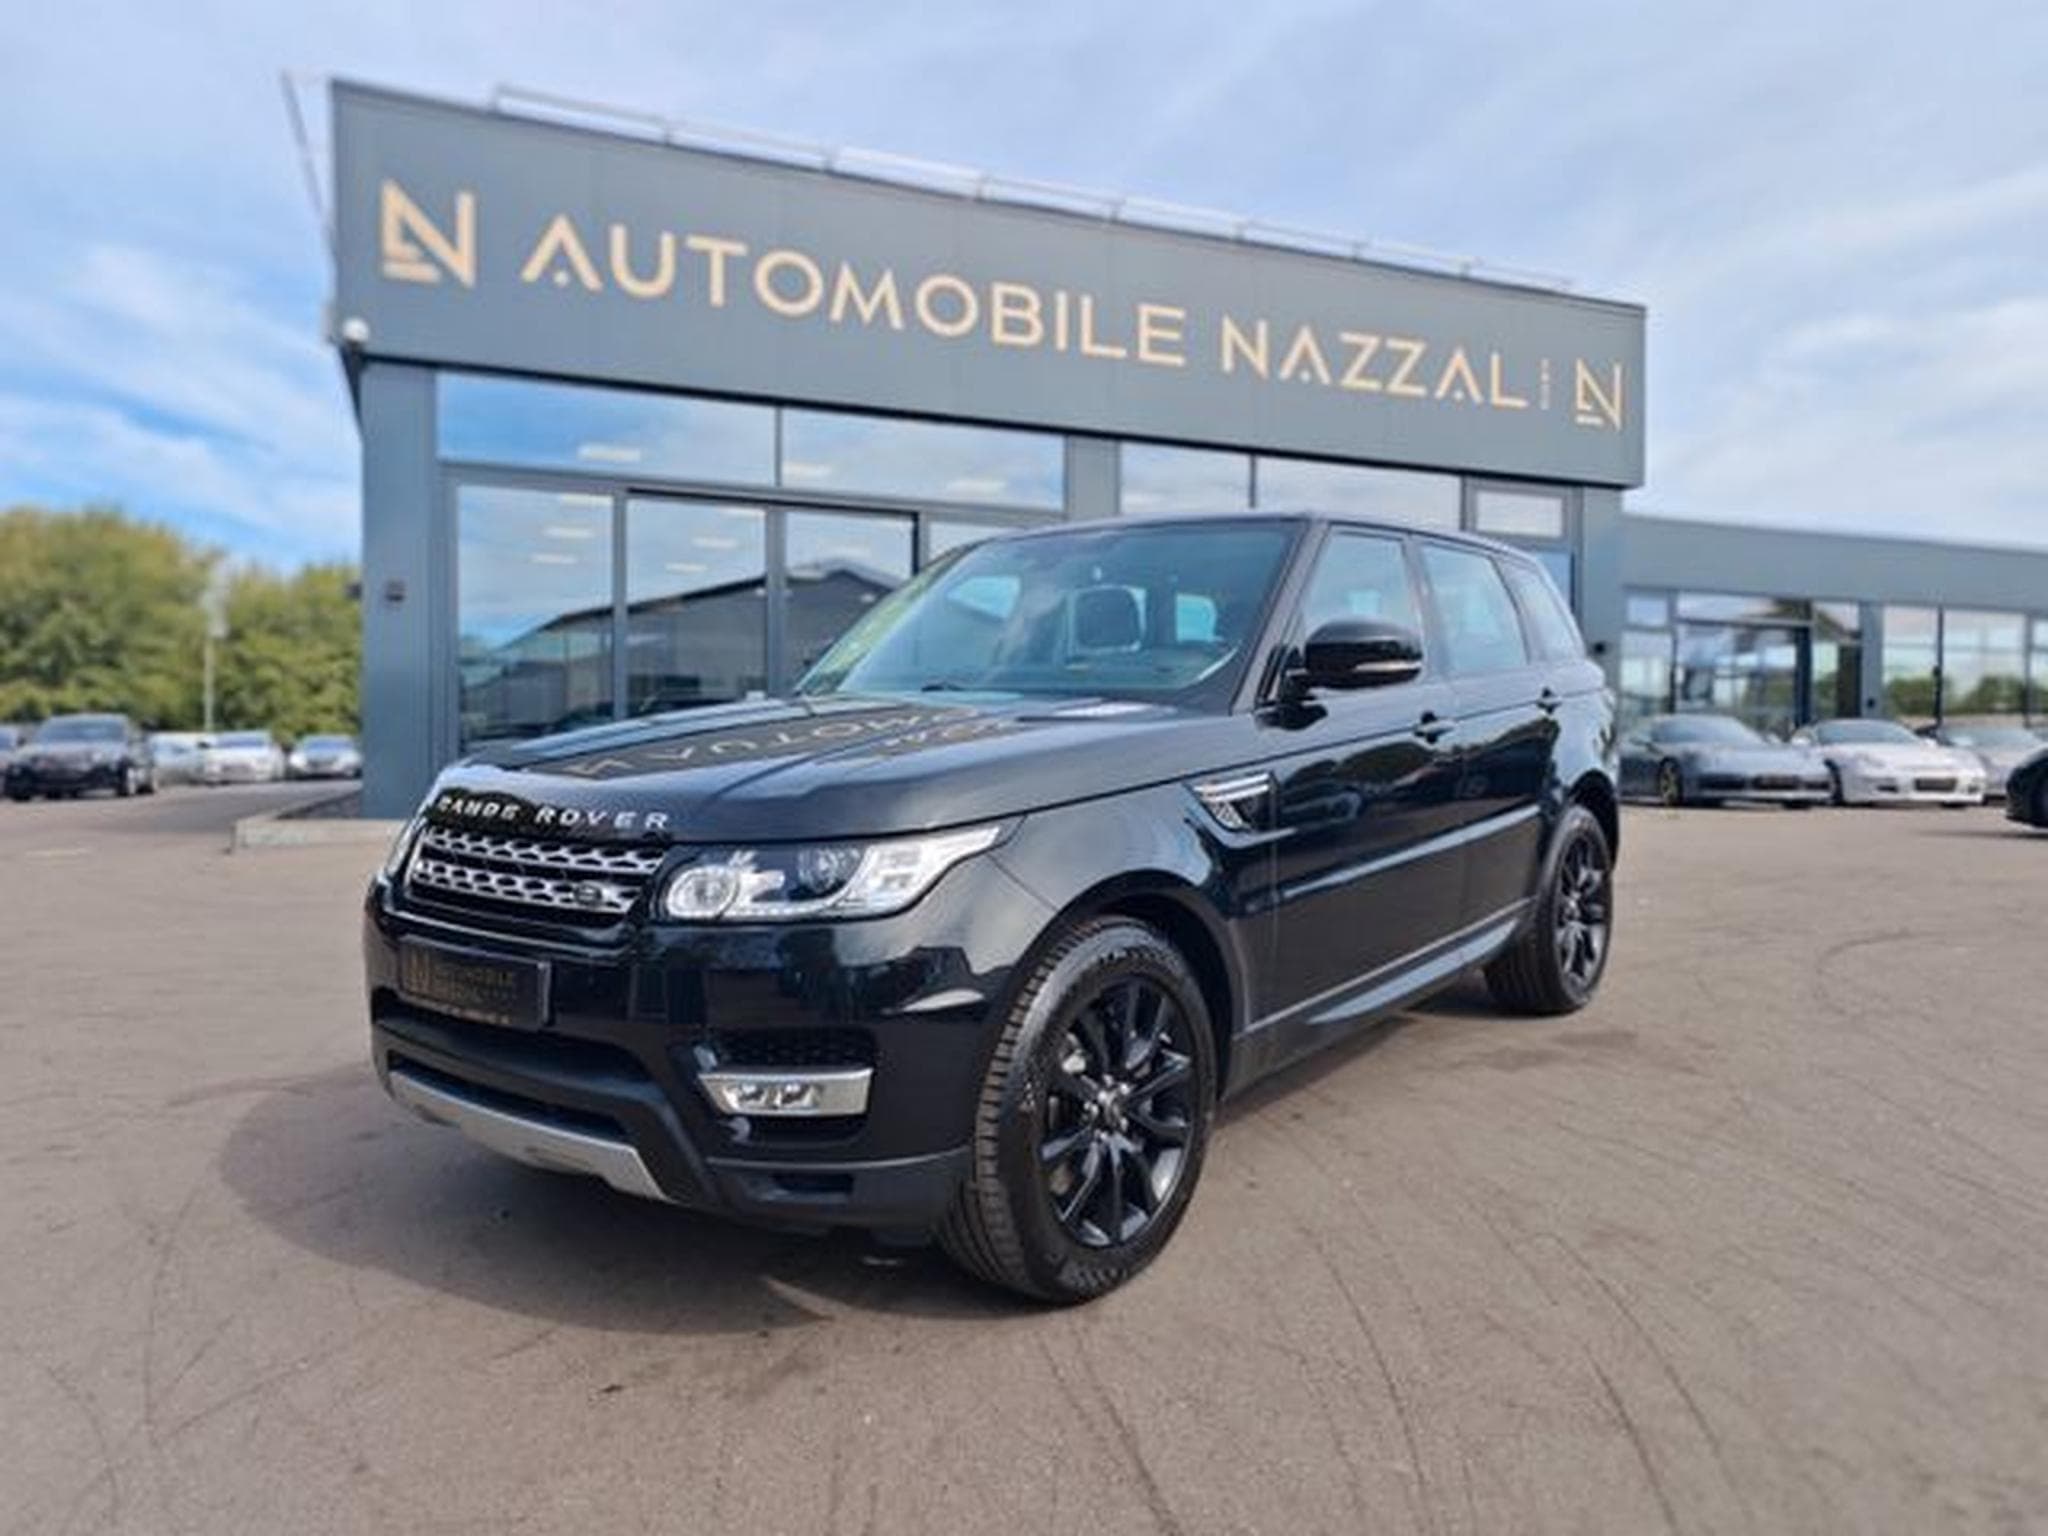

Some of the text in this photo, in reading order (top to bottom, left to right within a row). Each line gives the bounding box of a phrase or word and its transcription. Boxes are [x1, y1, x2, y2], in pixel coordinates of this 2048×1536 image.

[520, 213, 1187, 367] AUTOMOBILE
[1220, 315, 1530, 410] NAZZAL
[534, 804, 669, 831] ROVER
